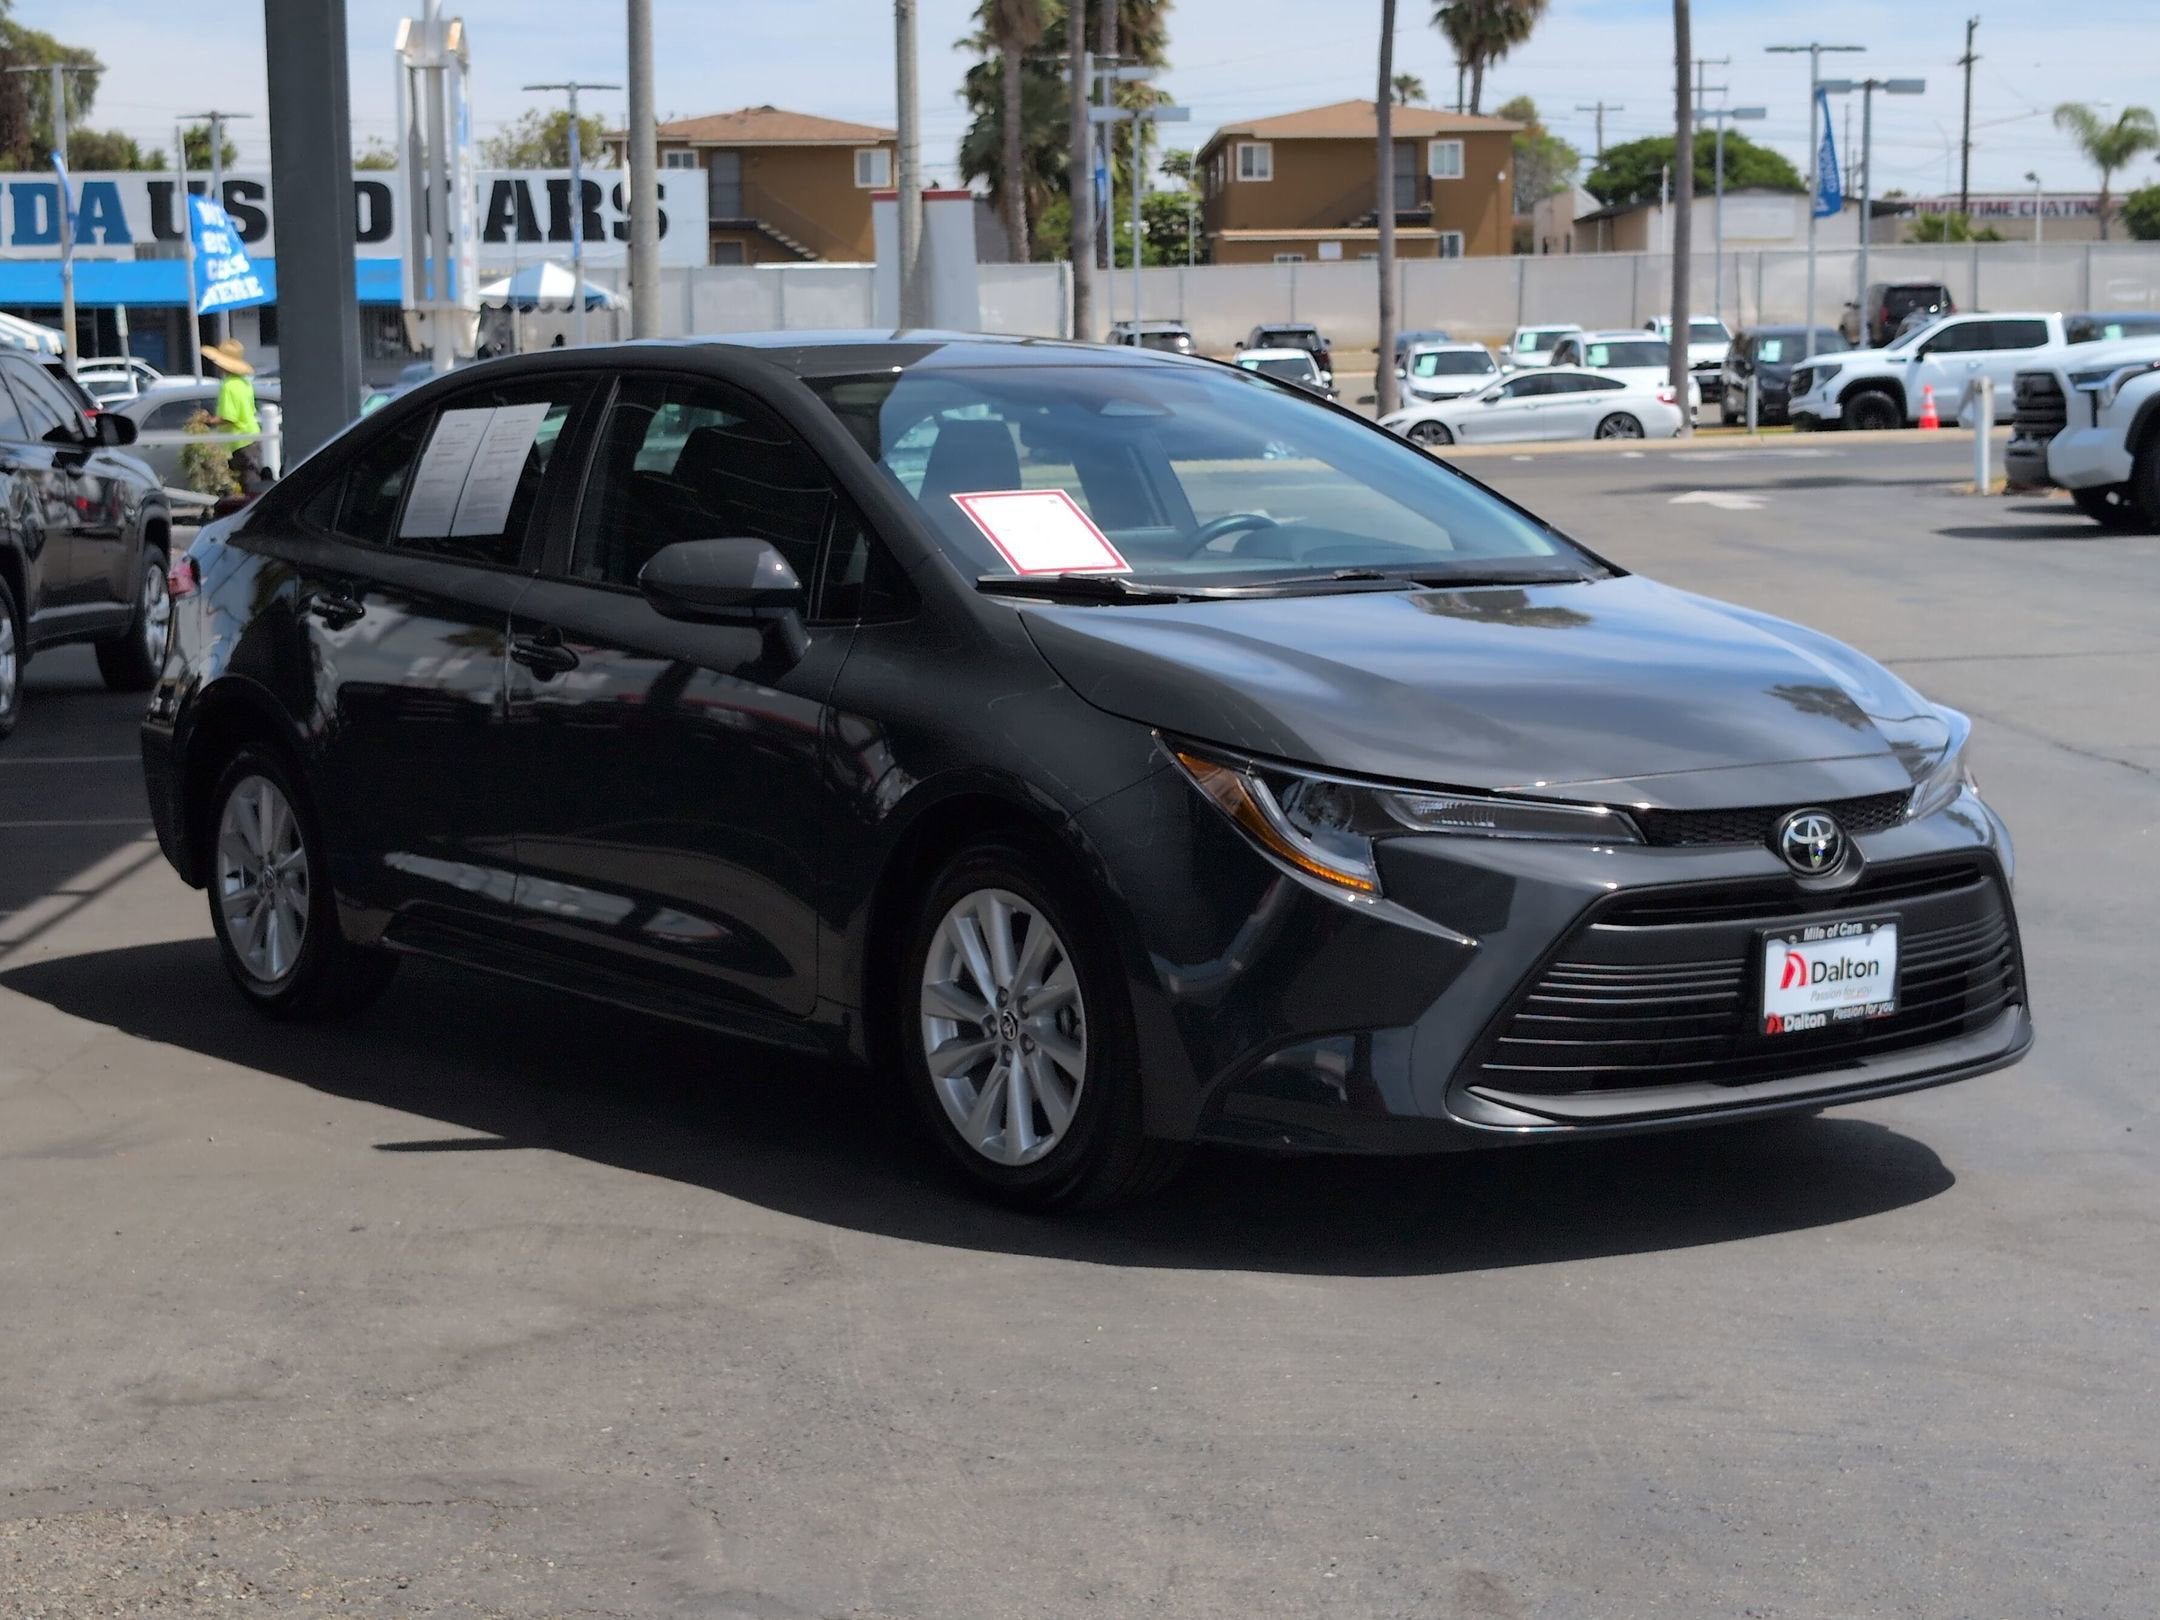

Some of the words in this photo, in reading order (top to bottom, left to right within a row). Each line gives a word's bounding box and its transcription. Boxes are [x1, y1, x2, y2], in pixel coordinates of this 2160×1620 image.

[0, 180, 134, 245] DA
[147, 180, 392, 244] USD
[426, 179, 668, 243] AR
[1803, 927, 1826, 941] Mile
[1827, 924, 1839, 938] of
[1839, 923, 1863, 935] Cars
[1811, 957, 1879, 984] Dalton
[1810, 989, 1842, 1001] Passion
[1833, 1006, 1865, 1020] Passion
[1865, 1003, 1878, 1016] for
[1877, 1002, 1894, 1016] you
[1784, 1013, 1826, 1032] Dalton
